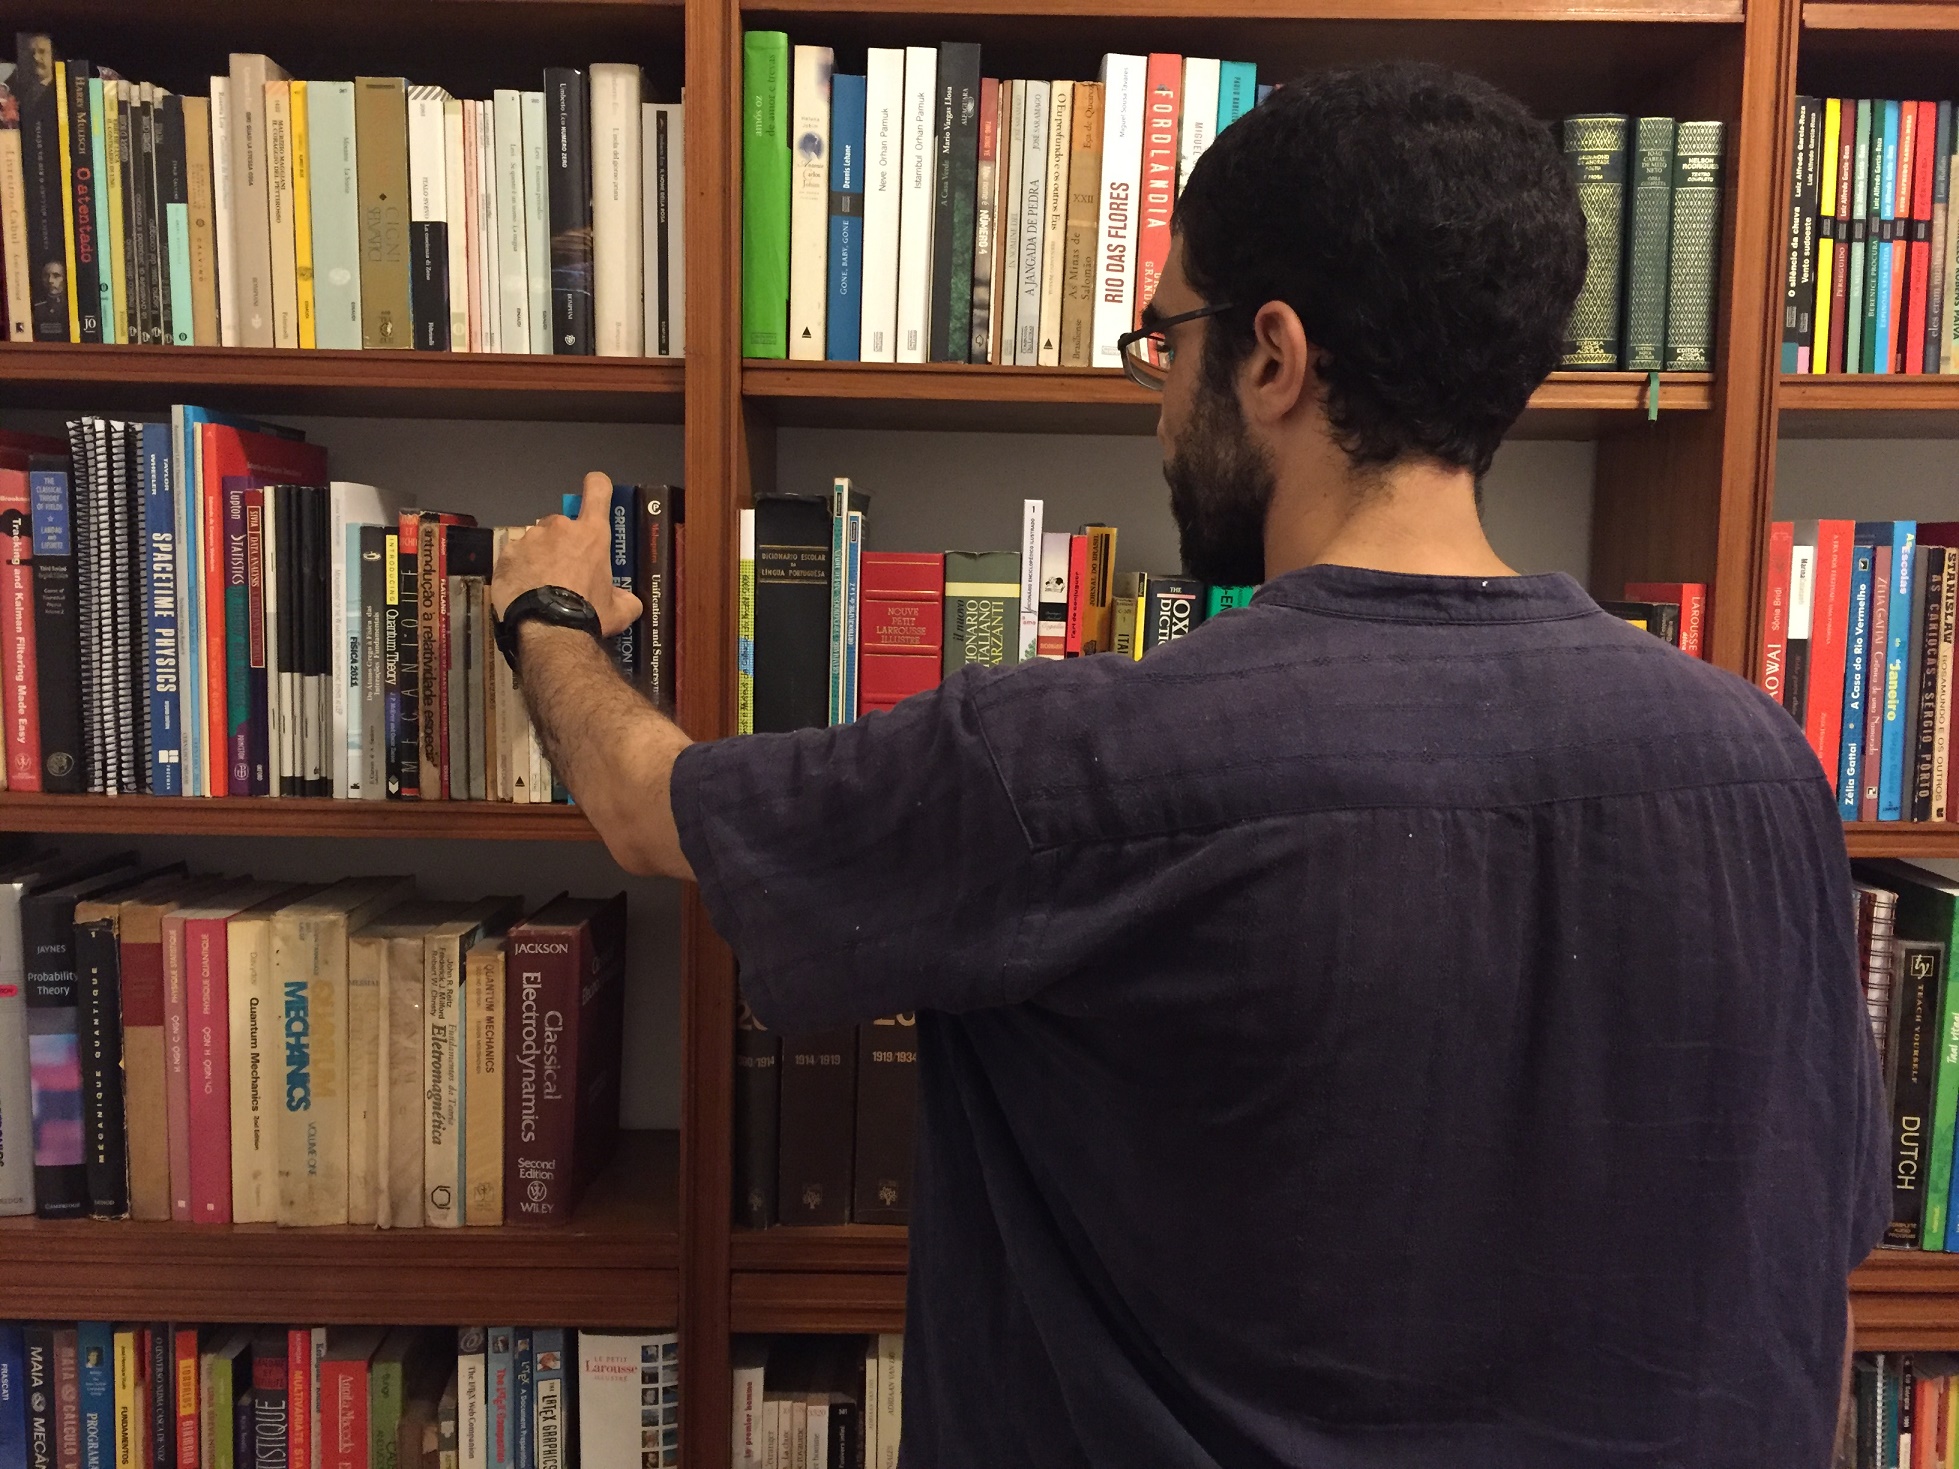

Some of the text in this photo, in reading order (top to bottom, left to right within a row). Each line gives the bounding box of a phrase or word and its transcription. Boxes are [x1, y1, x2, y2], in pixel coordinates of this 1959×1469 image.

[73, 76, 89, 154] HARRY MULISCH
[753, 95, 762, 137] amós oz
[942, 86, 953, 154] Mario Vargas Llosa
[1032, 93, 1041, 151] JOSÉ SARAMAGO
[1055, 93, 1066, 104] O
[1055, 104, 1066, 117] Eu
[560, 126, 568, 152] NUMERO
[878, 108, 889, 192] Neve Orhan Pamuk
[913, 92, 925, 189] Istambul Orhan Pamuk
[1053, 118, 1065, 163] profundo
[1147, 89, 1174, 229] FORDLÂNDIA
[1192, 122, 1203, 155] MIGUEL
[842, 144, 852, 189] Dennis Lehane
[1052, 172, 1063, 182] os
[77, 167, 93, 264] O atentado
[1027, 179, 1040, 216] PEDRA
[1050, 214, 1061, 231] Eus
[1051, 184, 1062, 212] outros
[1790, 206, 1801, 234] chuva
[385, 207, 401, 262] CIGNI
[1026, 218, 1039, 234] DE
[1104, 182, 1129, 303] RIO DAS FLORES
[1789, 236, 1800, 248] da
[1801, 216, 1812, 283] Vento sudoeste
[1025, 236, 1038, 287] JANGADA
[1068, 232, 1081, 300] As Minas de
[1081, 256, 1093, 300] Salomão
[1788, 250, 1800, 288] silêncio
[1837, 246, 1846, 297] PERSEGUIDO
[1868, 239, 1878, 317] BERENICE PROCURA
[230, 490, 244, 519] Lupton
[249, 510, 258, 528] SIVIA
[230, 534, 246, 585] STATISTICS
[614, 506, 626, 565] GRIFFITHS
[802, 554, 826, 562] ESCOLAR
[249, 536, 260, 588] DATA ANALYSIS
[388, 538, 396, 602] INTRODUCING
[788, 570, 826, 578] PORTUGUESA
[1089, 534, 1100, 606] JORNAL DO BRASIL
[152, 532, 177, 692] SPACETIME PHYSICS
[888, 607, 919, 616] NOUVE
[892, 616, 916, 626] PETIT
[953, 599, 965, 642] il nuovo
[1771, 587, 1782, 630] Sônia Bridi
[1943, 552, 1957, 644] STANISLAW
[11, 518, 28, 744] Tracking and Kalman Filtering Made Easy
[384, 609, 399, 685] Quantum Theory
[876, 626, 926, 636] LARROUSSE
[1688, 596, 1701, 652] LAROUSSE
[1851, 584, 1867, 709] A Casa do Rio Vermelho
[1925, 574, 1941, 675] AS CARIOCAS
[350, 636, 360, 687] FÍSICA 2011
[1886, 663, 1899, 721] Janeiro
[1938, 655, 1948, 725] ROSAMUNDO
[1936, 737, 1946, 752] OS
[1845, 742, 1857, 805] Zélia Gattai
[1935, 757, 1945, 801] OUTROS
[37, 945, 66, 954] JAYNES
[515, 943, 568, 956] JACKSON
[28, 970, 79, 983] Probability
[38, 985, 70, 998] Theory
[484, 964, 495, 1074] QUANTUM MECHANICS
[1910, 984, 1924, 1084] TEACH YOURSELF
[91, 967, 105, 1164] MÉCANIQUE QUANTIQUE
[249, 997, 262, 1112] Quantum Mechanics
[284, 982, 311, 1112] MECHANICS
[516, 972, 542, 1142] Electrodynamics
[544, 1010, 563, 1100] Classical
[427, 1024, 447, 1145] Eletromagnética
[448, 1024, 458, 1126] Fundamentos da Teoria
[308, 1122, 316, 1176] VOLUME ONE
[518, 1158, 556, 1170] Second
[518, 1169, 555, 1180] Edition
[1898, 1116, 1920, 1190] DUTCH
[520, 1202, 554, 1214] WILEY
[0, 1364, 9, 1400] FRASCATI
[468, 1366, 476, 1380] The
[584, 1360, 638, 1374] Larousse
[154, 1336, 165, 1461] O UNIVERSO NUMA CASCA DE NOZ
[294, 1370, 304, 1444] MULTIVARIATE
[468, 1402, 476, 1416] Web
[120, 1406, 130, 1464] FUNDAMENTOS
[466, 1418, 476, 1458] Companion
